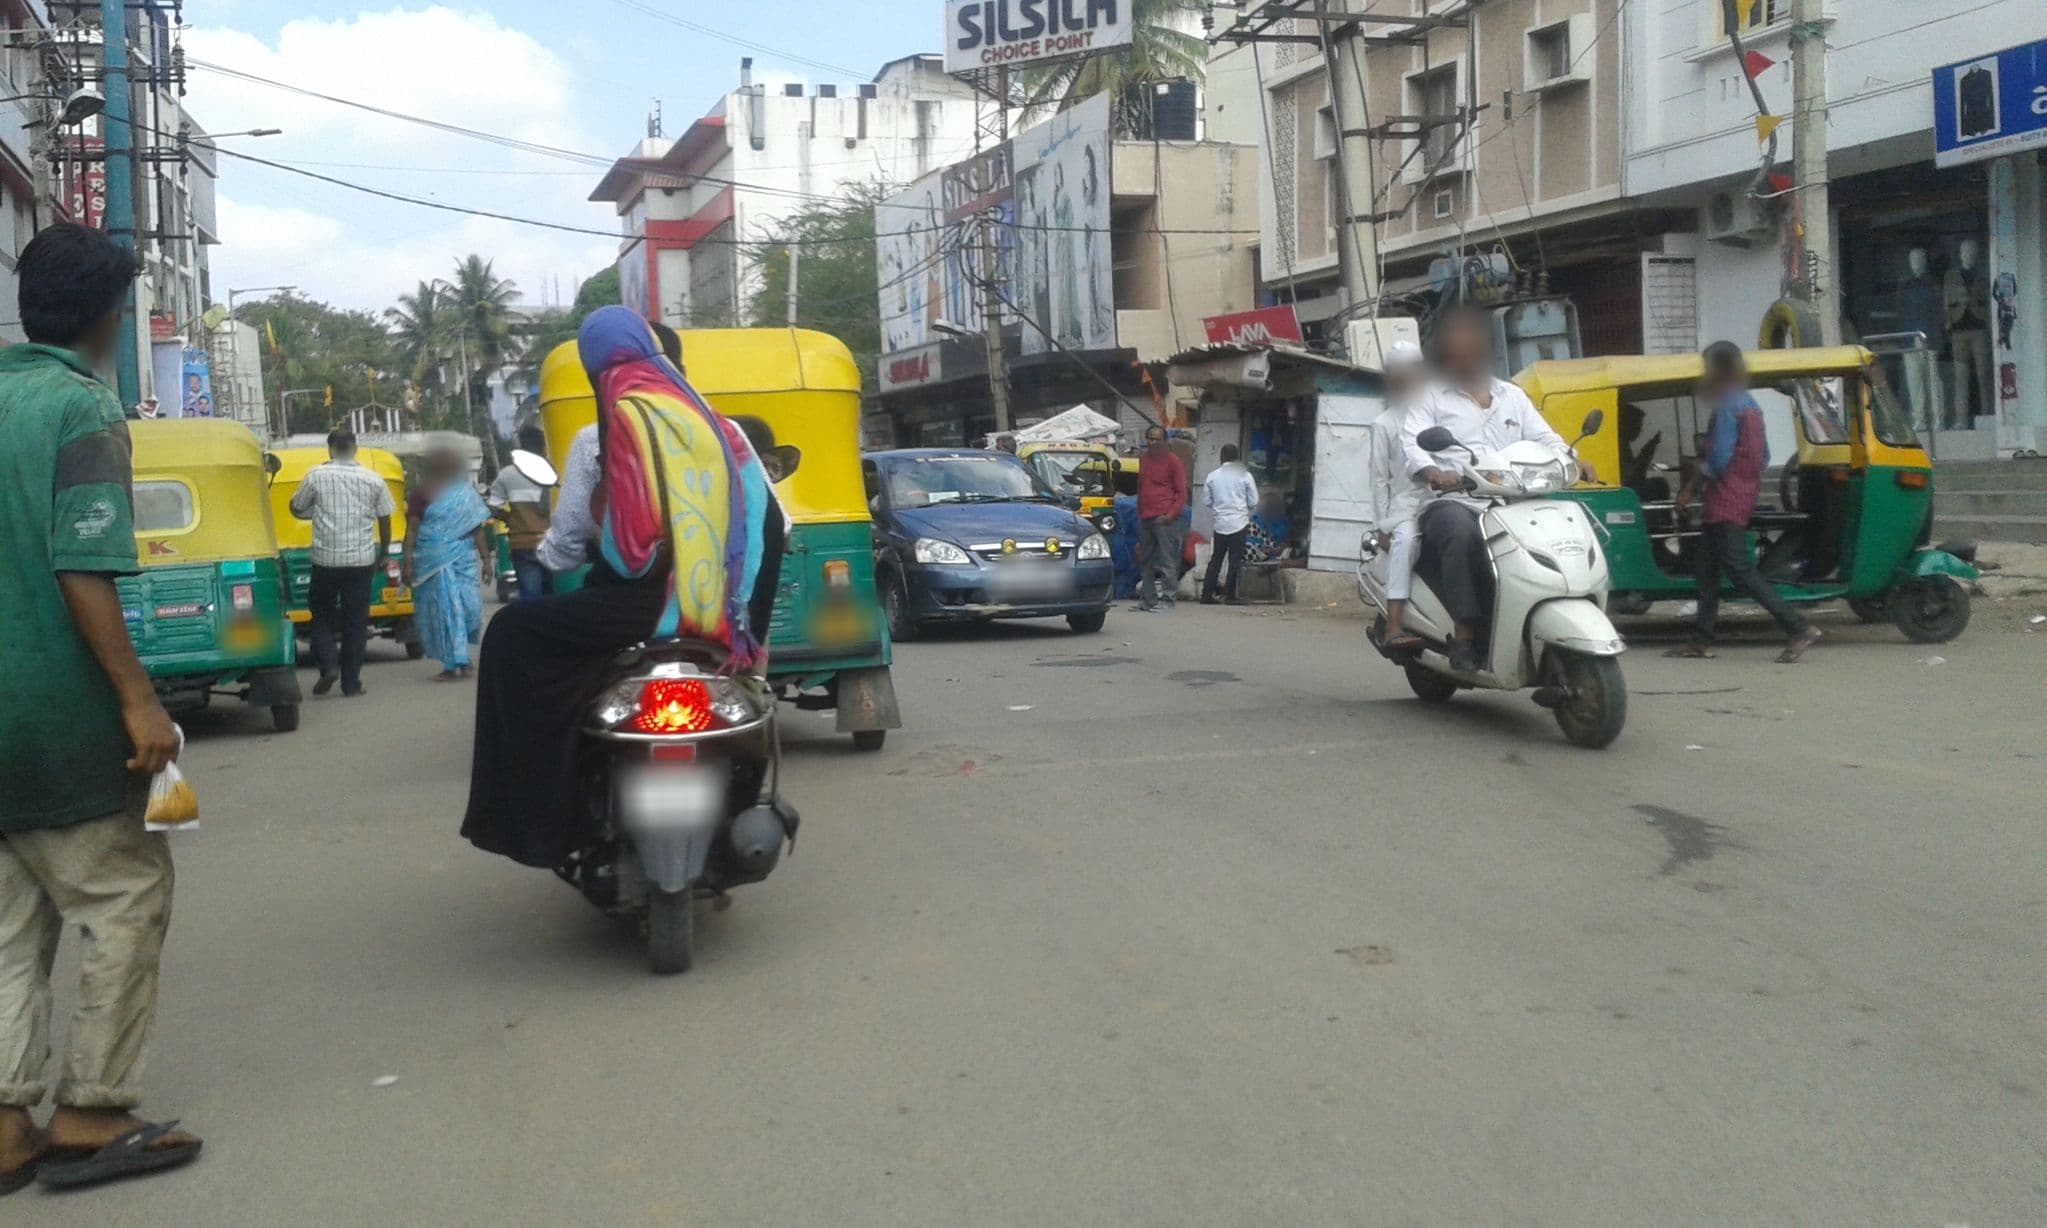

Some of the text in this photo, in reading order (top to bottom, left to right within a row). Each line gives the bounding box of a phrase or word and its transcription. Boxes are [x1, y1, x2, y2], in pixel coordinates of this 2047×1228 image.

[981, 31, 1094, 63] CHOICE POINT
[1228, 322, 1272, 344] LAVA
[148, 540, 177, 556] K
